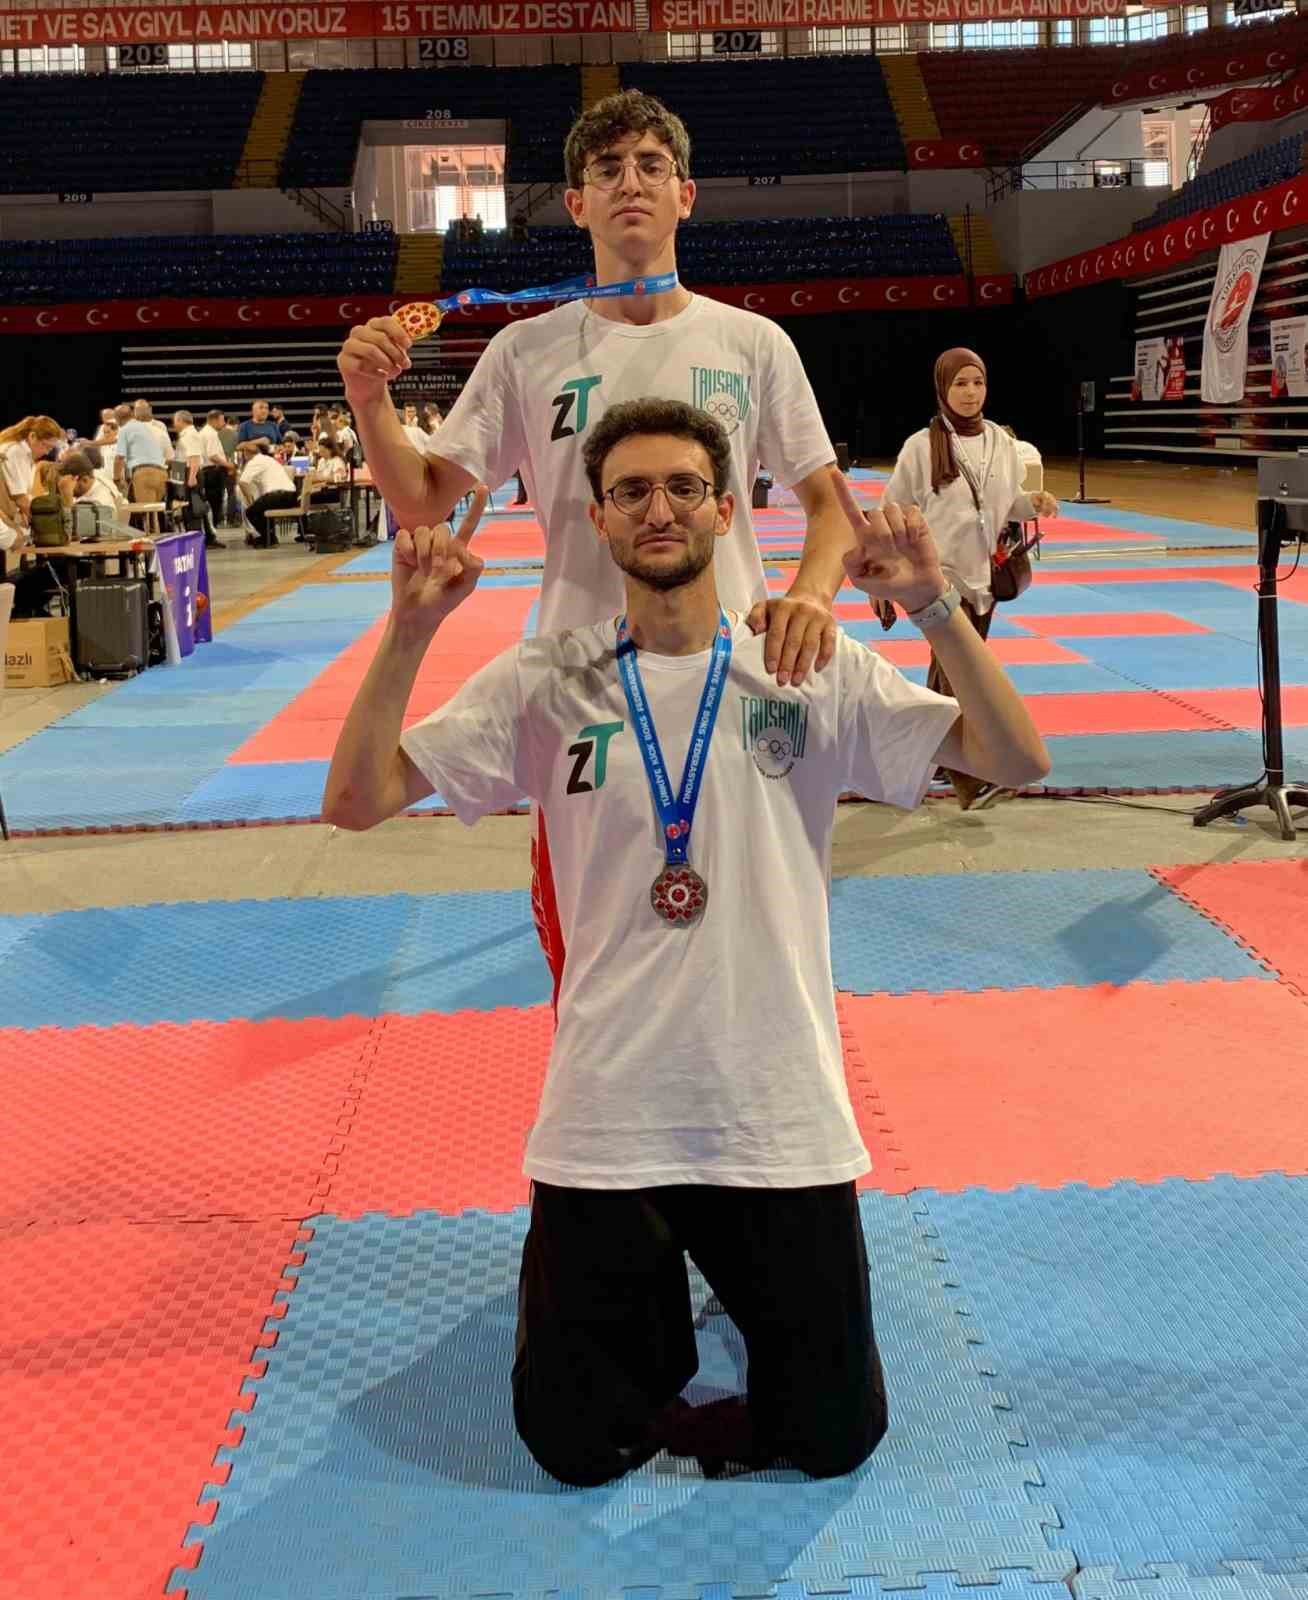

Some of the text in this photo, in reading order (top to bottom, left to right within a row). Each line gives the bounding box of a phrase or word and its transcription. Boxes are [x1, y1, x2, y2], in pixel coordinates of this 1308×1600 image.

[382, 2, 632, 32] 15 TEMMUZ DESTANI
[894, 0, 921, 19] VE
[42, 13, 79, 40] VE
[219, 7, 347, 35] ANIYORUZ
[420, 38, 468, 59] 208
[714, 31, 762, 52] 207
[121, 45, 168, 65] 209
[425, 109, 452, 120] 208
[753, 175, 776, 185] 207
[64, 193, 87, 203] 209
[366, 221, 392, 233] 109
[566, 720, 625, 795] ZT
